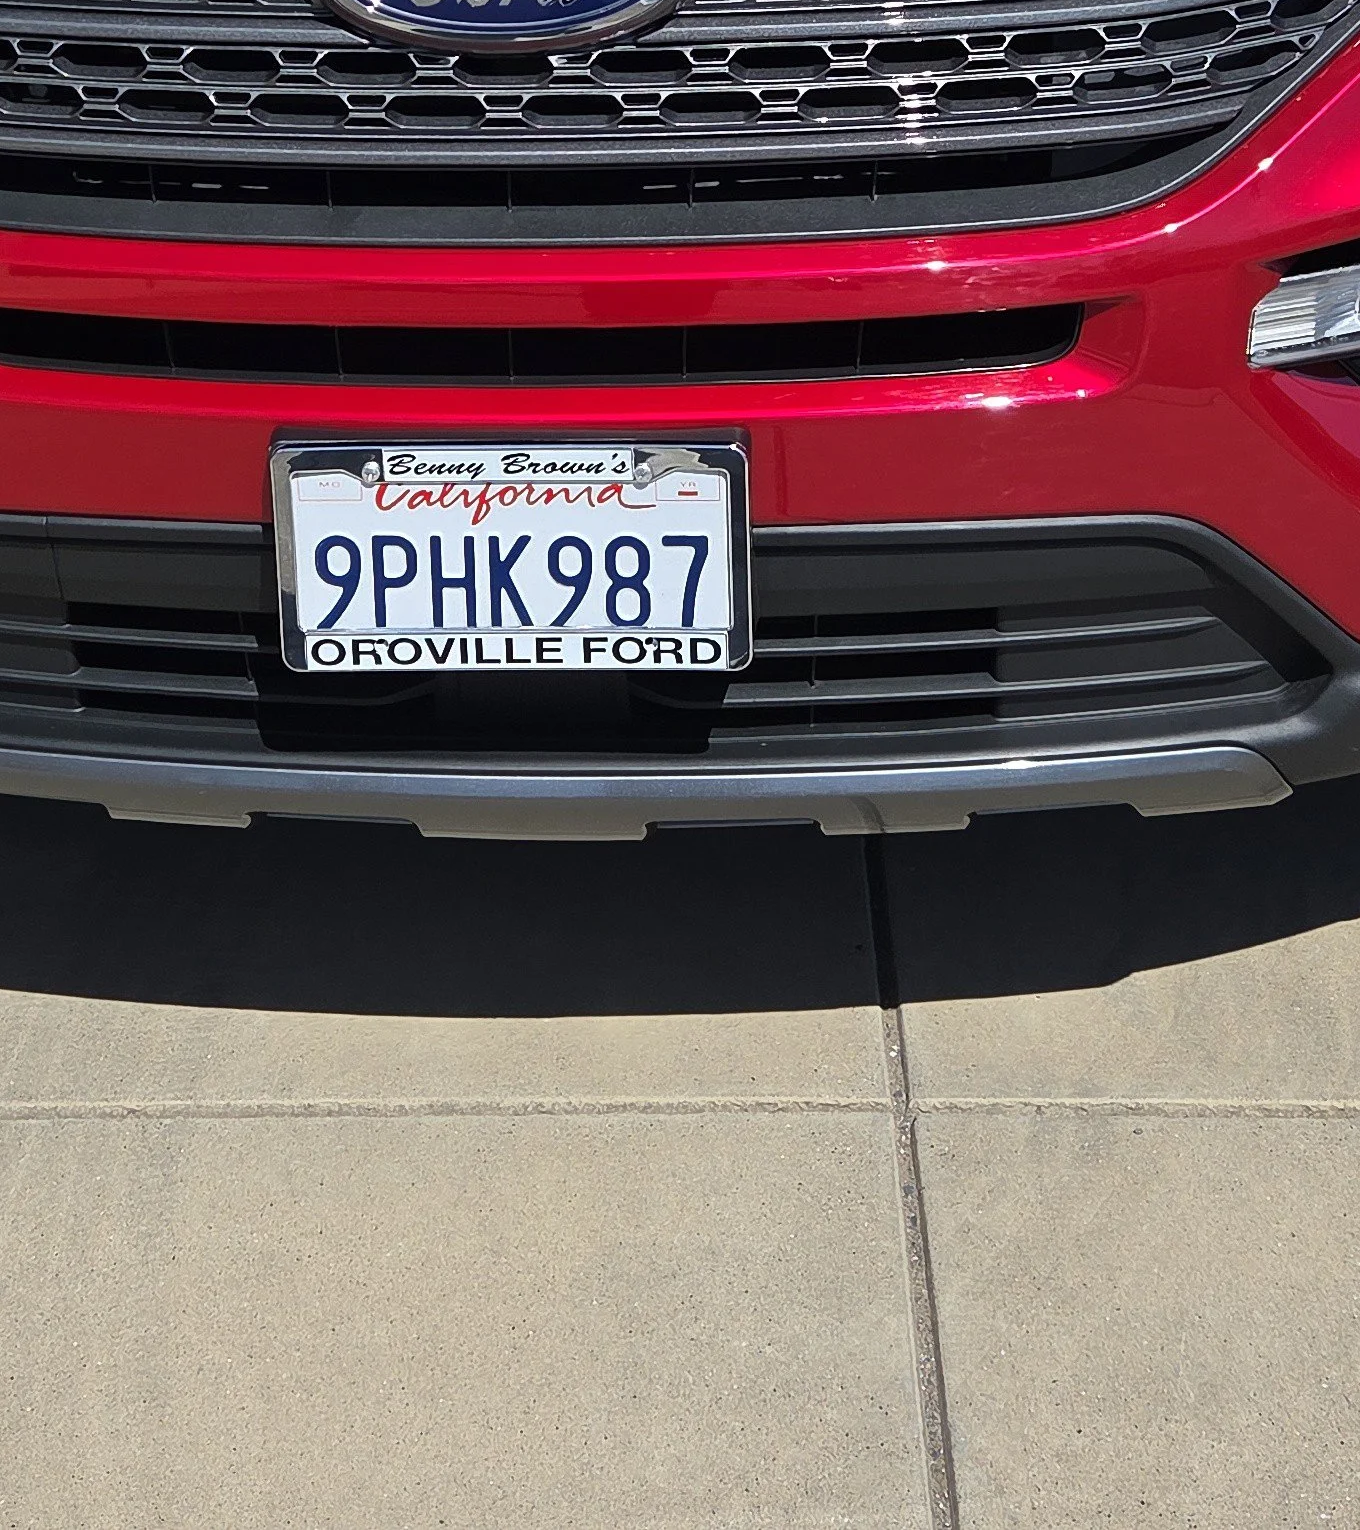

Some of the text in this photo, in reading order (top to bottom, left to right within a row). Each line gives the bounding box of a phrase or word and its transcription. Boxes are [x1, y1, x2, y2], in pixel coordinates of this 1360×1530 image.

[387, 453, 630, 478] Benny Brown's
[375, 482, 656, 525] California
[315, 535, 709, 629] 9PHK987
[311, 636, 723, 666] OROVILLE FORD
